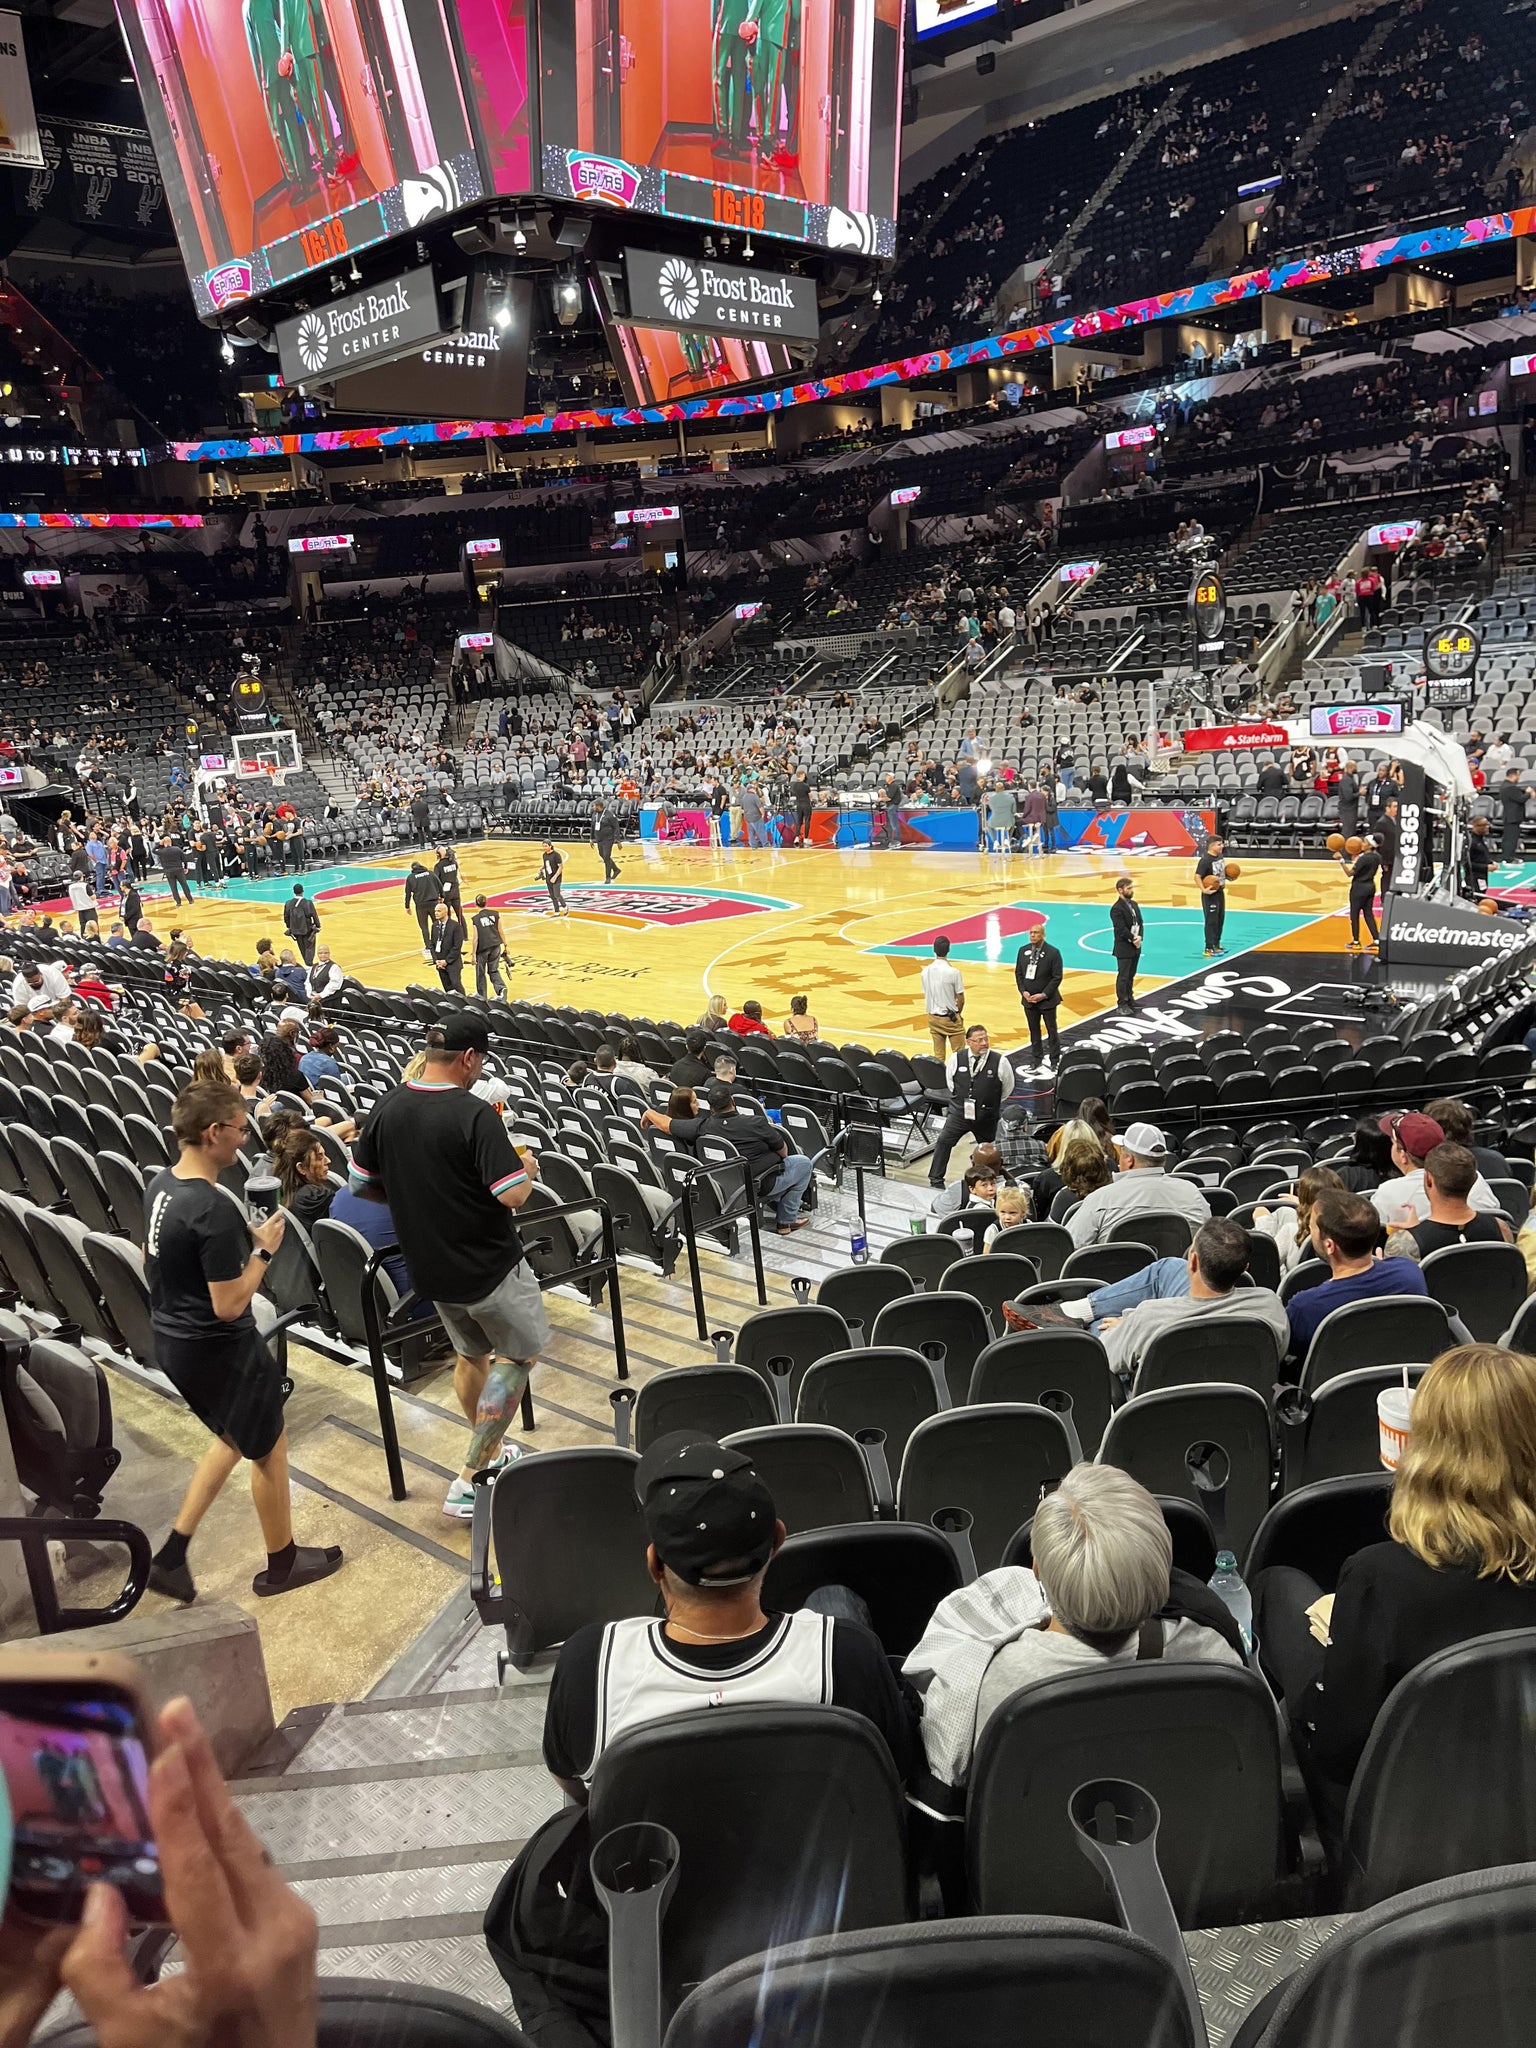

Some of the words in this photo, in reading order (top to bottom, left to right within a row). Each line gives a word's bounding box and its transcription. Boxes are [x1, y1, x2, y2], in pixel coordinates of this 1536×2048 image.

[71, 143, 110, 153] WESTERN
[79, 134, 110, 147] NBA
[66, 148, 118, 160] CONFERENCE
[69, 155, 118, 166] CHAMPIONS
[73, 163, 118, 178] 2013
[578, 169, 624, 192] SPURS
[712, 187, 766, 231] 16:18
[300, 218, 349, 268] 16:18
[213, 273, 243, 297] SPURS
[701, 268, 748, 302] Frost
[748, 276, 796, 309] Bank
[327, 304, 368, 338] Frost
[366, 281, 411, 323] Bank
[716, 306, 783, 329] CENTER
[342, 325, 401, 356] CENTER
[422, 350, 487, 367] CENTER
[68, 448, 81, 456] BLK
[1440, 677, 1473, 687] TISSOT
[1336, 715, 1379, 727] SPURS
[1395, 803, 1421, 885] bet365
[1390, 921, 1527, 951] ticketmaster
[567, 962, 652, 979] Bank
[1167, 971, 1292, 1011] San
[425, 1334, 432, 1344] 11
[280, 1382, 291, 1394] 12
[104, 1454, 117, 1467] 13
